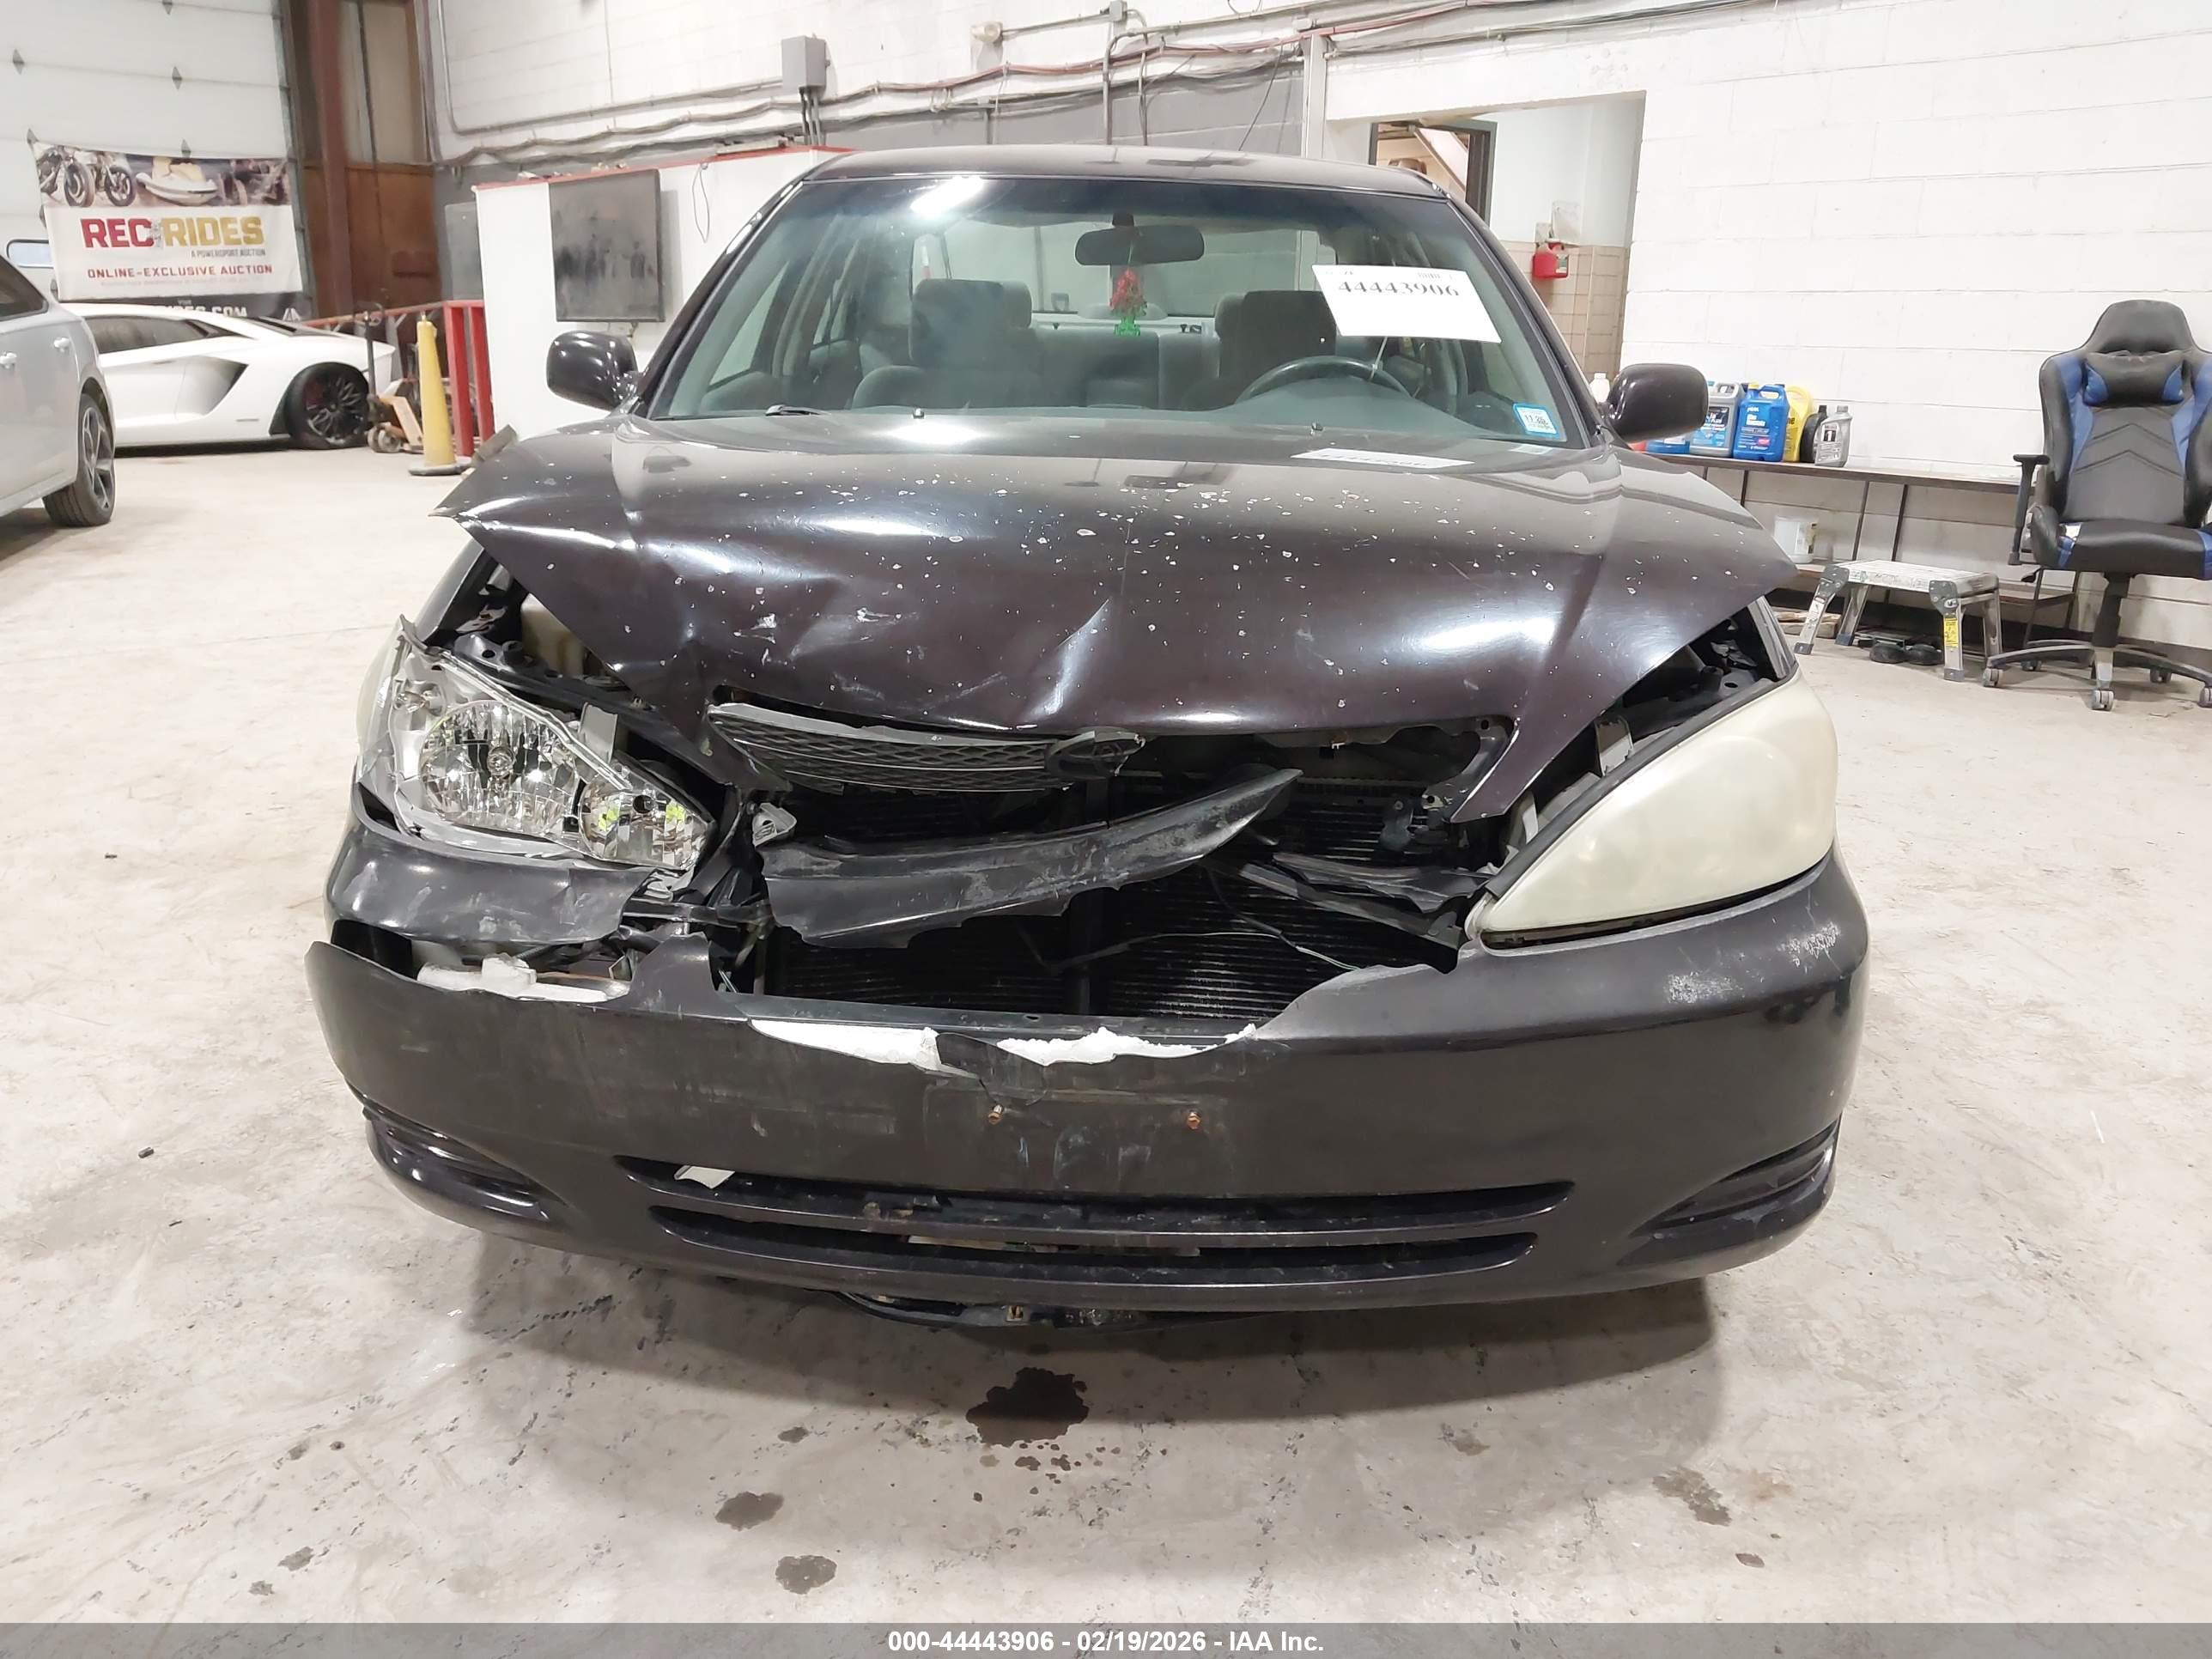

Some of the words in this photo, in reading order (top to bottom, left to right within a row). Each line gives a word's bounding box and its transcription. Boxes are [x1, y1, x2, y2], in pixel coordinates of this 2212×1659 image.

[81, 218, 155, 248] REC
[161, 216, 264, 247] RIDES
[88, 266, 216, 278] ONLINE-EXCLUSIVE
[220, 264, 273, 275] AUCTION
[1338, 281, 1461, 296] 44443906
